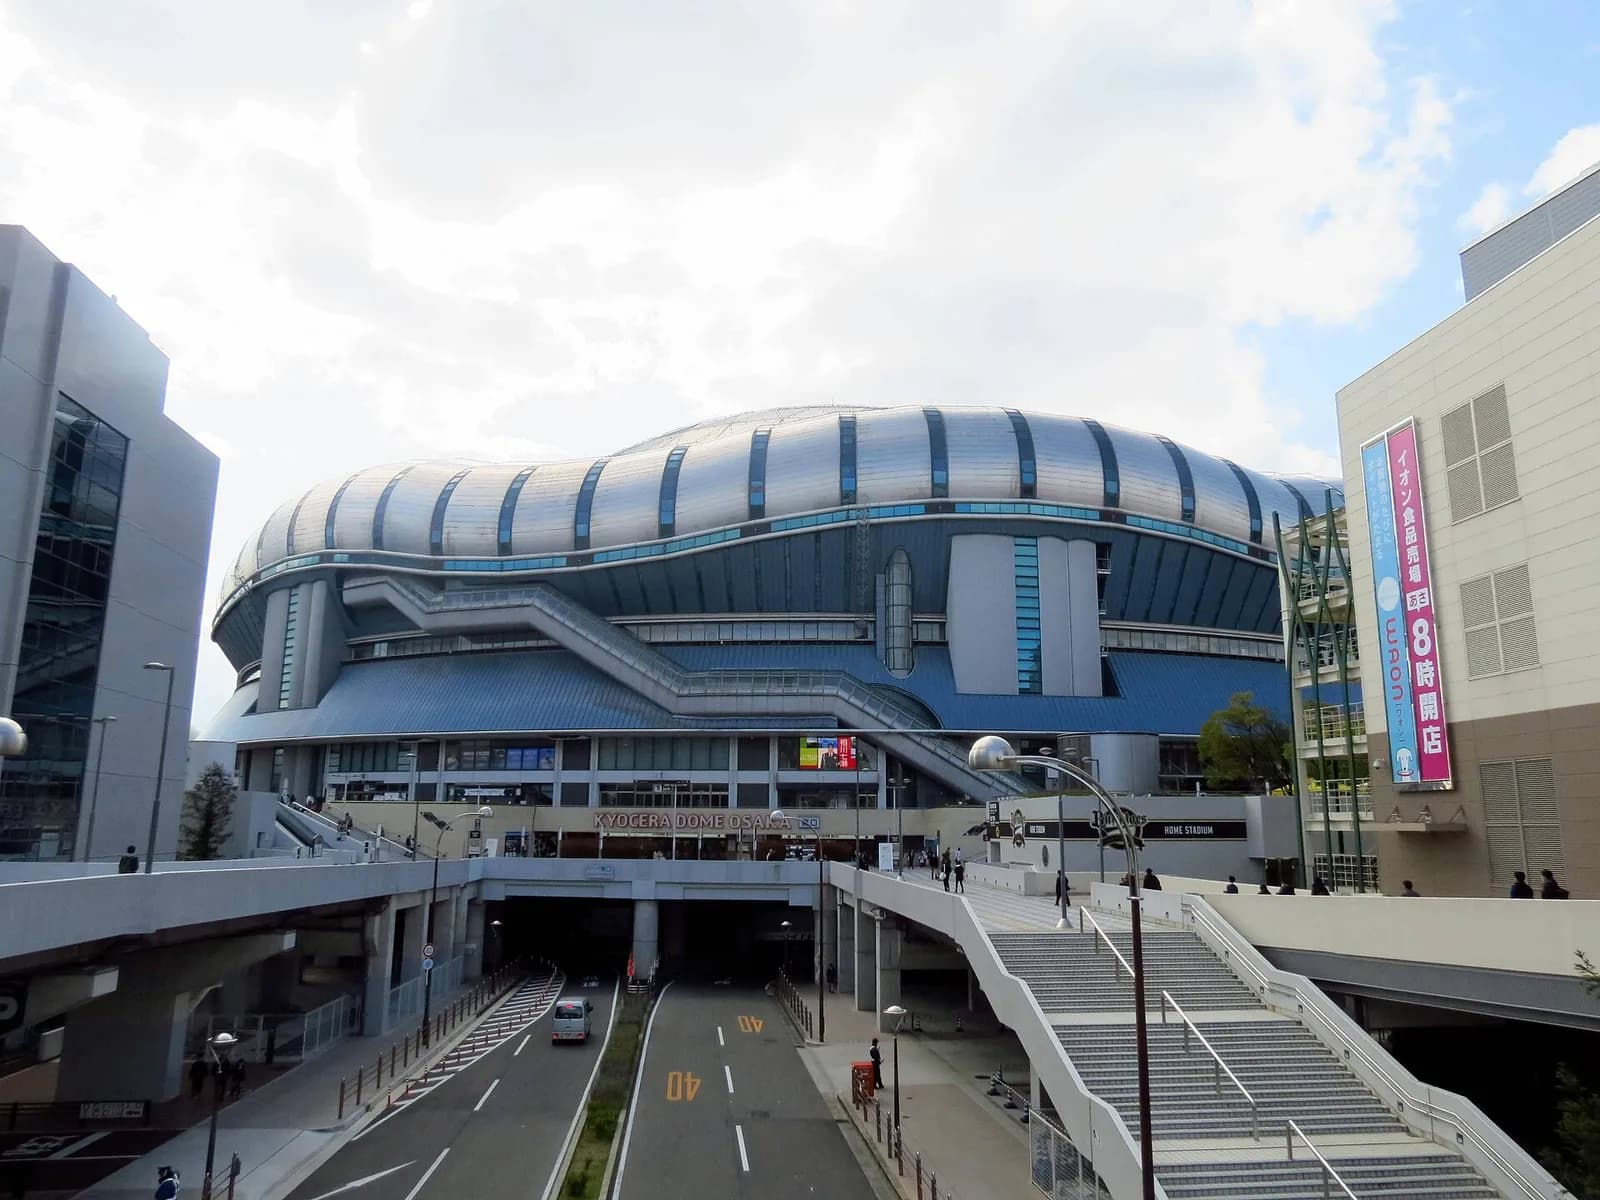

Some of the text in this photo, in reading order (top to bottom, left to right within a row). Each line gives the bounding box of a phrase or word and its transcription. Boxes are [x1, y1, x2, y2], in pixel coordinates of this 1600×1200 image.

[1397, 449, 1422, 584] イオン食品売場
[1412, 618, 1443, 755] 8時開店
[594, 813, 672, 829] KYOCERA
[676, 814, 725, 829] DOME
[1164, 825, 1214, 835] HOME STADIUM
[736, 1015, 765, 1033] 40
[665, 1071, 703, 1102] 40
